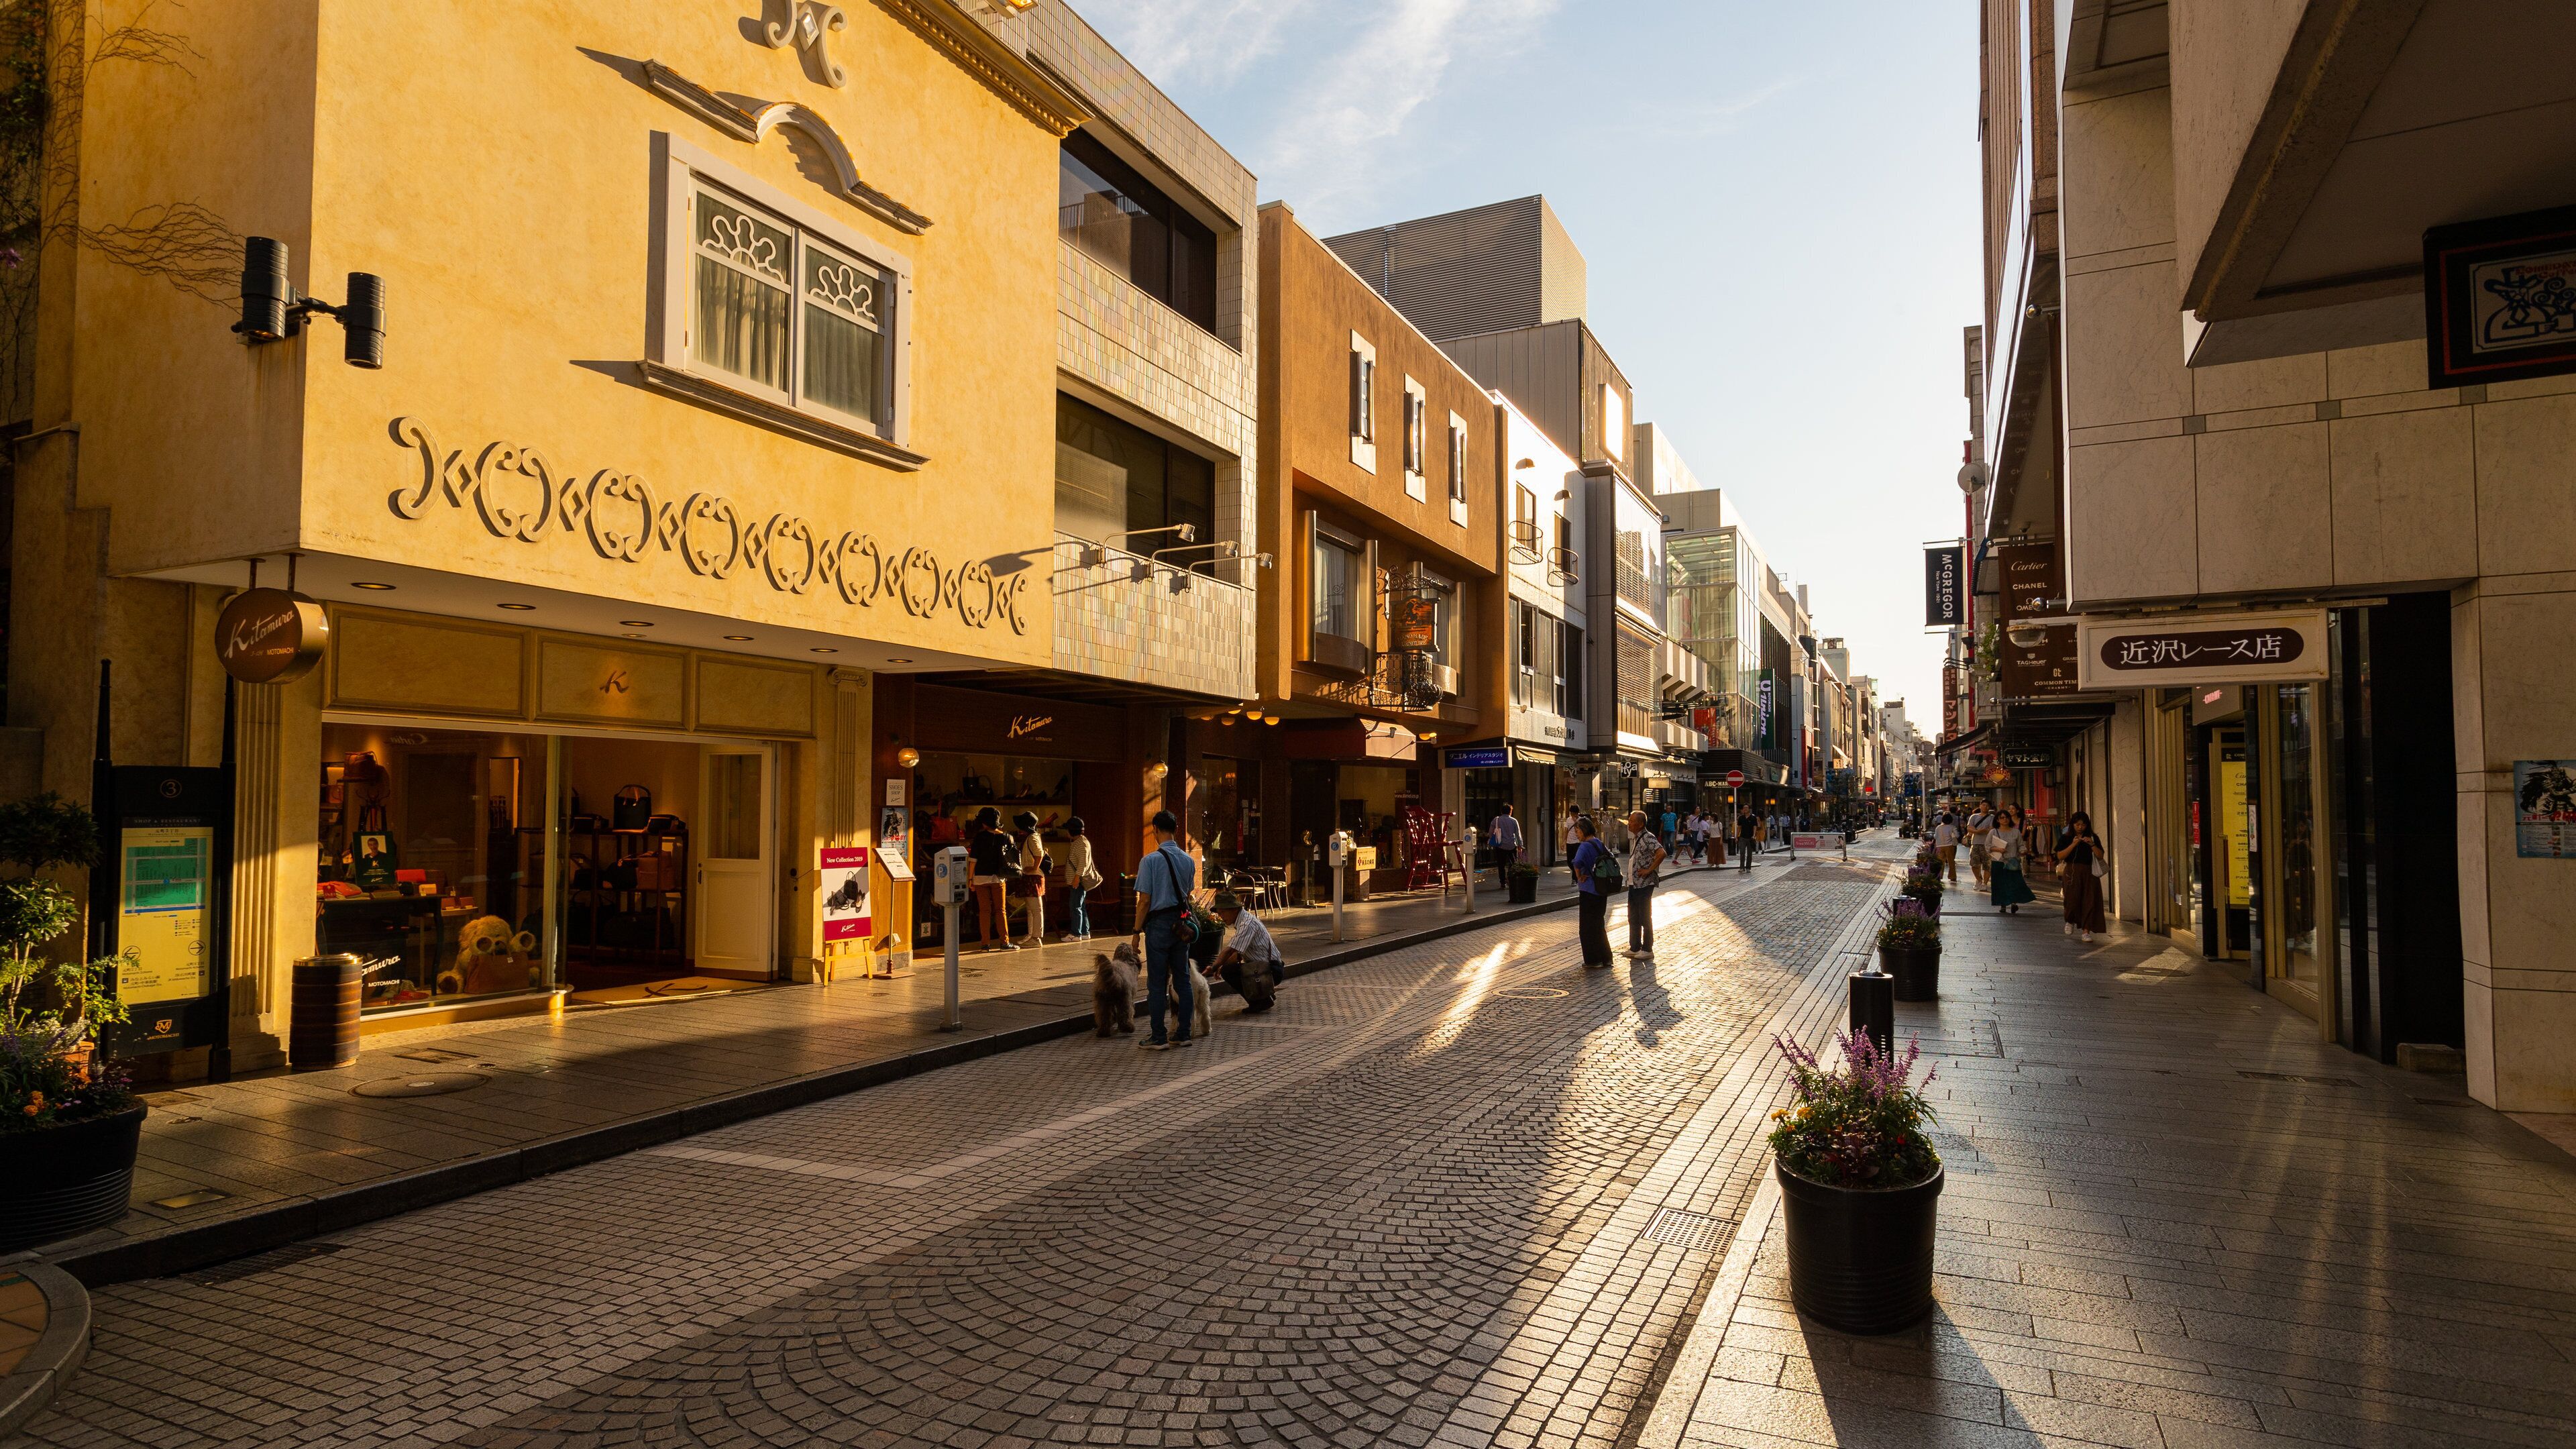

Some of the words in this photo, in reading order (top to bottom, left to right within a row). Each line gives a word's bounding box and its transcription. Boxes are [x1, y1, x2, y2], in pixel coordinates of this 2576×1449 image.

[2011, 561, 2047, 572] Cartier
[2012, 582, 2047, 590] CHANEL
[225, 610, 294, 658] Kitamura
[267, 647, 294, 655] MOTOMACHI
[2121, 635, 2282, 665] 近沢レース店
[600, 670, 629, 694] K
[1007, 715, 1053, 739] Kitamura
[166, 782, 176, 796] 3
[362, 956, 400, 976] amura
[368, 979, 400, 987] MOTOMACHI
